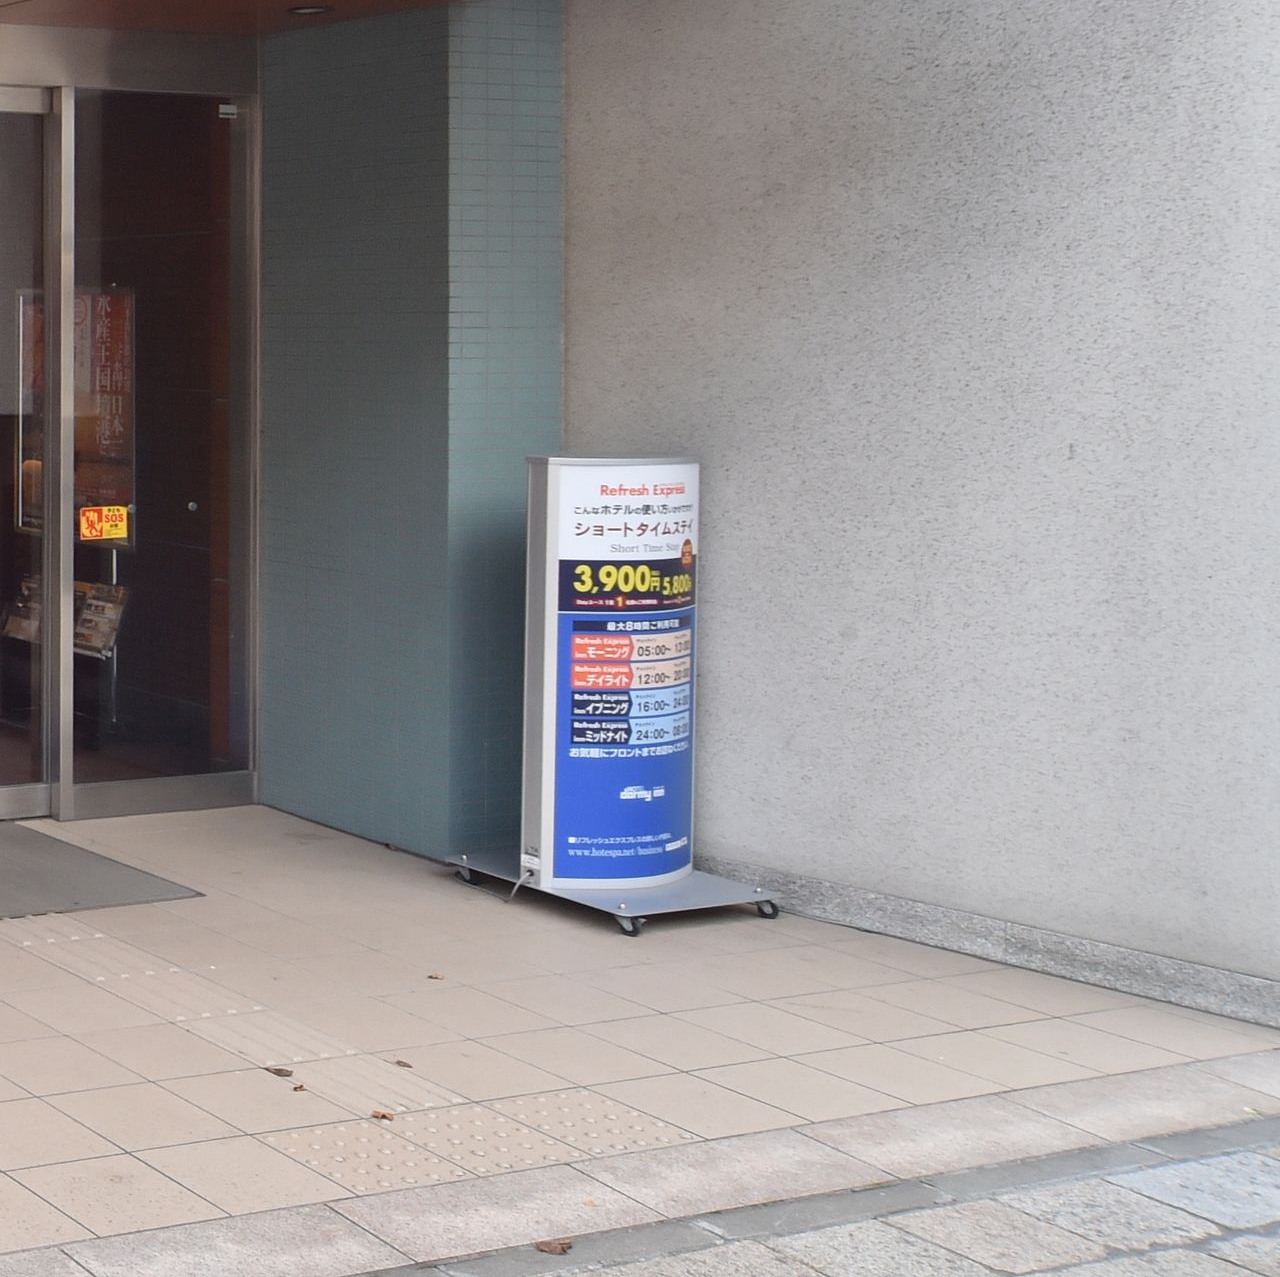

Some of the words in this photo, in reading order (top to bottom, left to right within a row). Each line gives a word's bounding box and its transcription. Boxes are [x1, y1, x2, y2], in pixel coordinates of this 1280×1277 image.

[600, 483, 649, 496] Refresh
[104, 513, 124, 523] SOS
[574, 519, 694, 538] ショートタイムステイ
[610, 543, 641, 554] Short
[643, 543, 664, 553] Time
